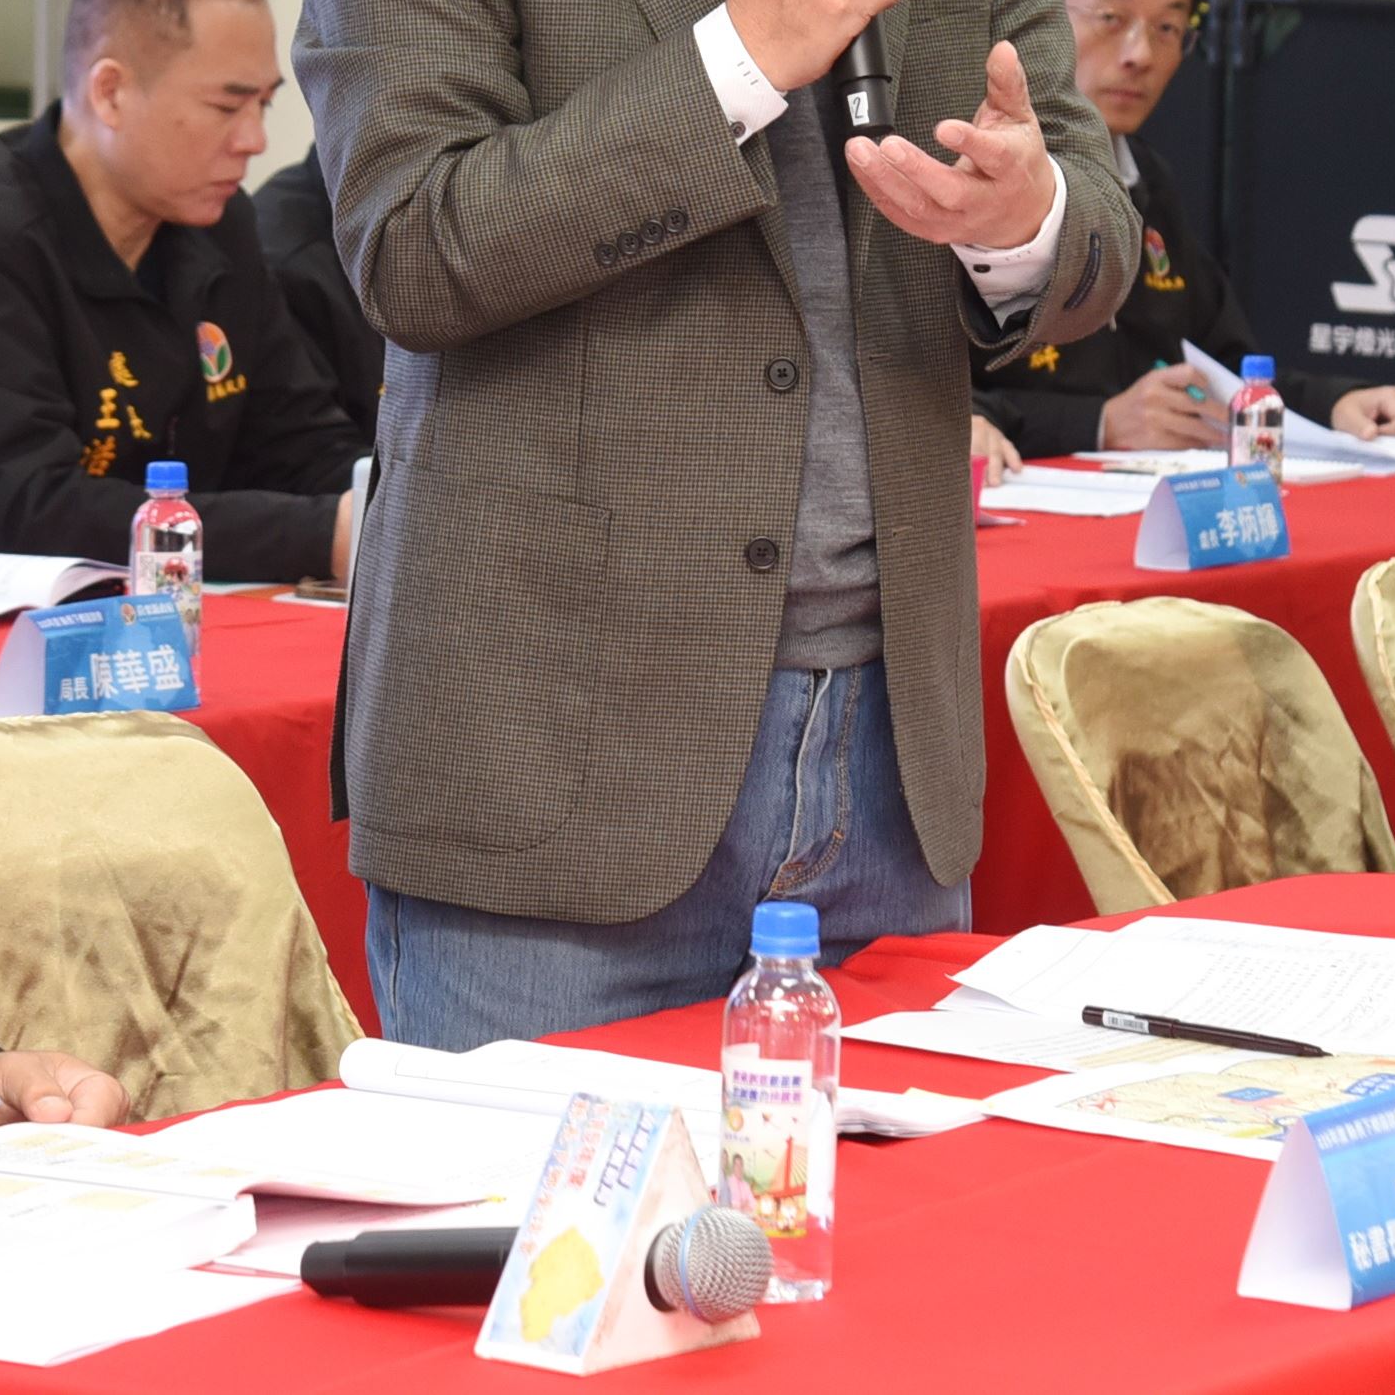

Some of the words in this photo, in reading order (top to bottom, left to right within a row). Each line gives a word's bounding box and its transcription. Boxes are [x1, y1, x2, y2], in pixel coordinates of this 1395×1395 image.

[853, 96, 864, 119] 2
[60, 677, 90, 701] 局長
[90, 644, 185, 700] 陳華盛
